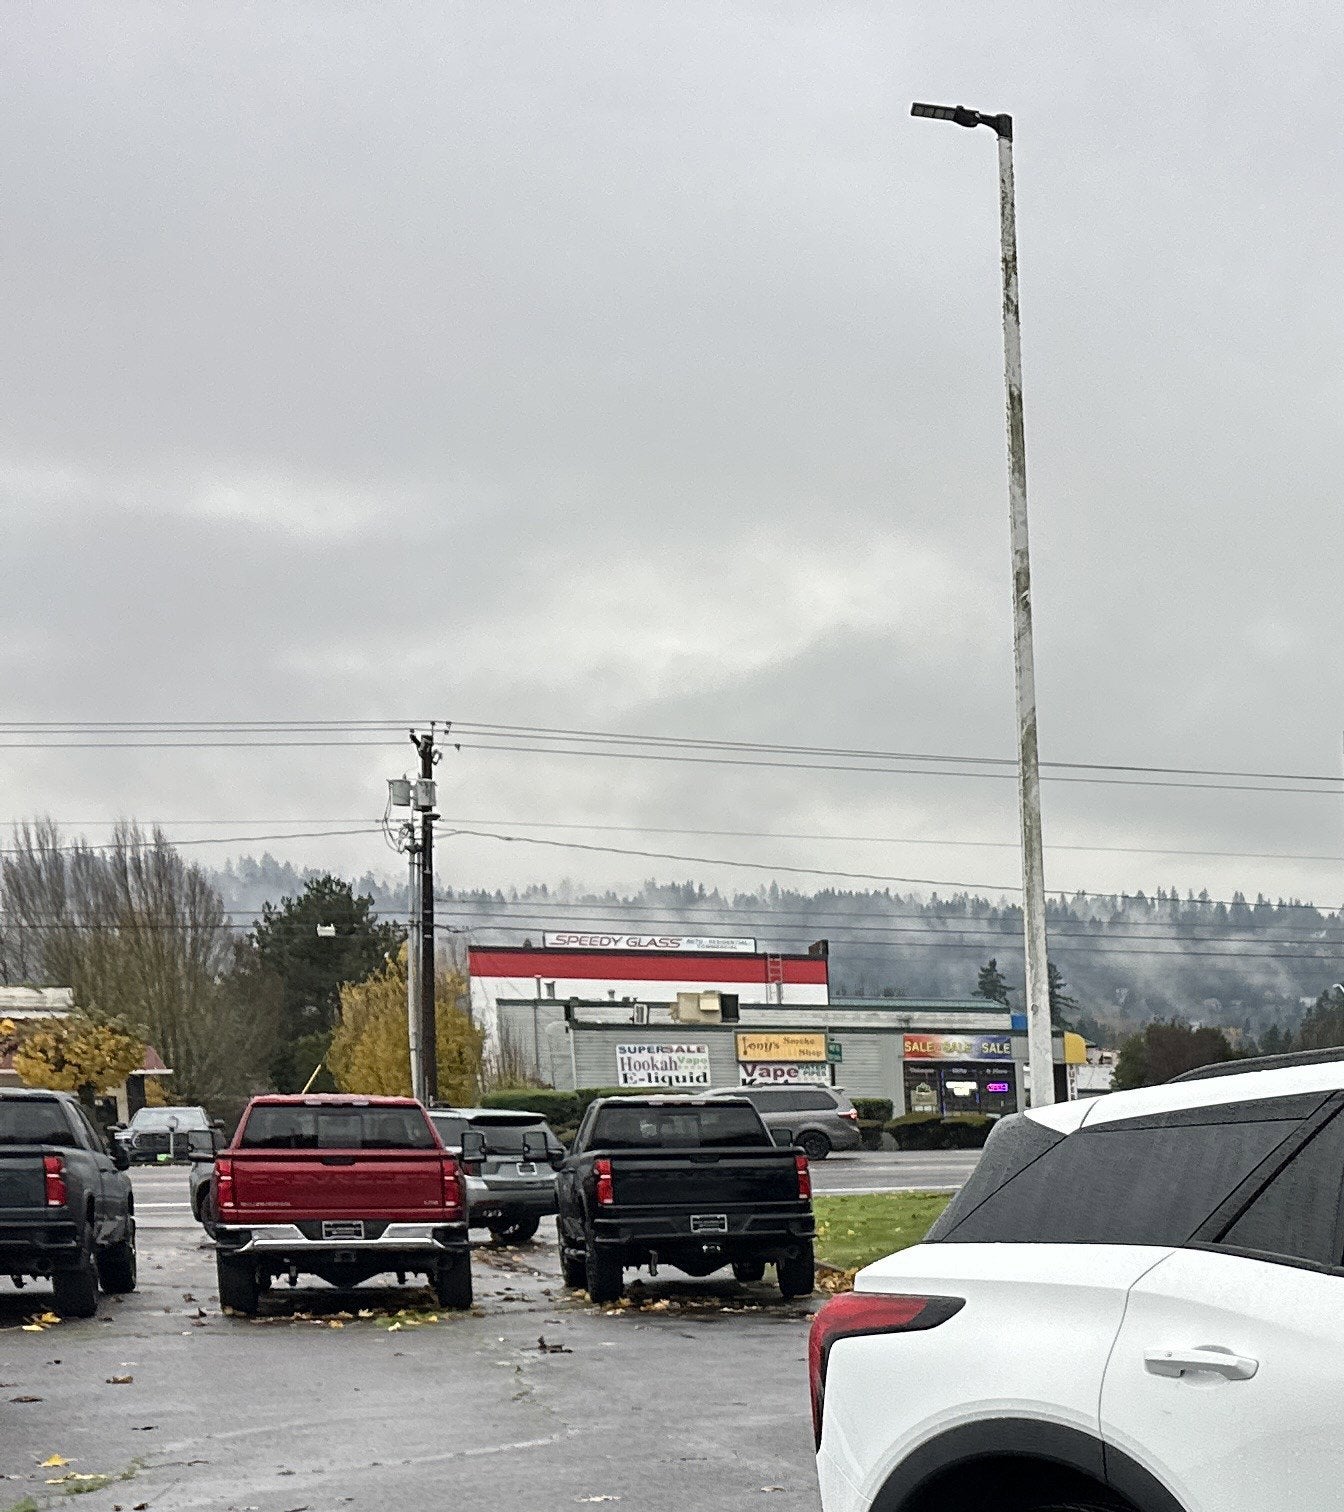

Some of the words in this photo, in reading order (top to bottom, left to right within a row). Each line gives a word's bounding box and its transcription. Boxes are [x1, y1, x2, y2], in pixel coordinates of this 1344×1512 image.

[549, 934, 623, 946] SPEEDY
[626, 936, 683, 948] GLASS
[904, 1041, 934, 1052] SALE
[981, 1042, 1011, 1054] SALE
[620, 1056, 678, 1071] Hookah
[677, 1056, 707, 1065] Vape
[740, 1062, 799, 1080] Vape
[622, 1072, 708, 1086] E-liquid
